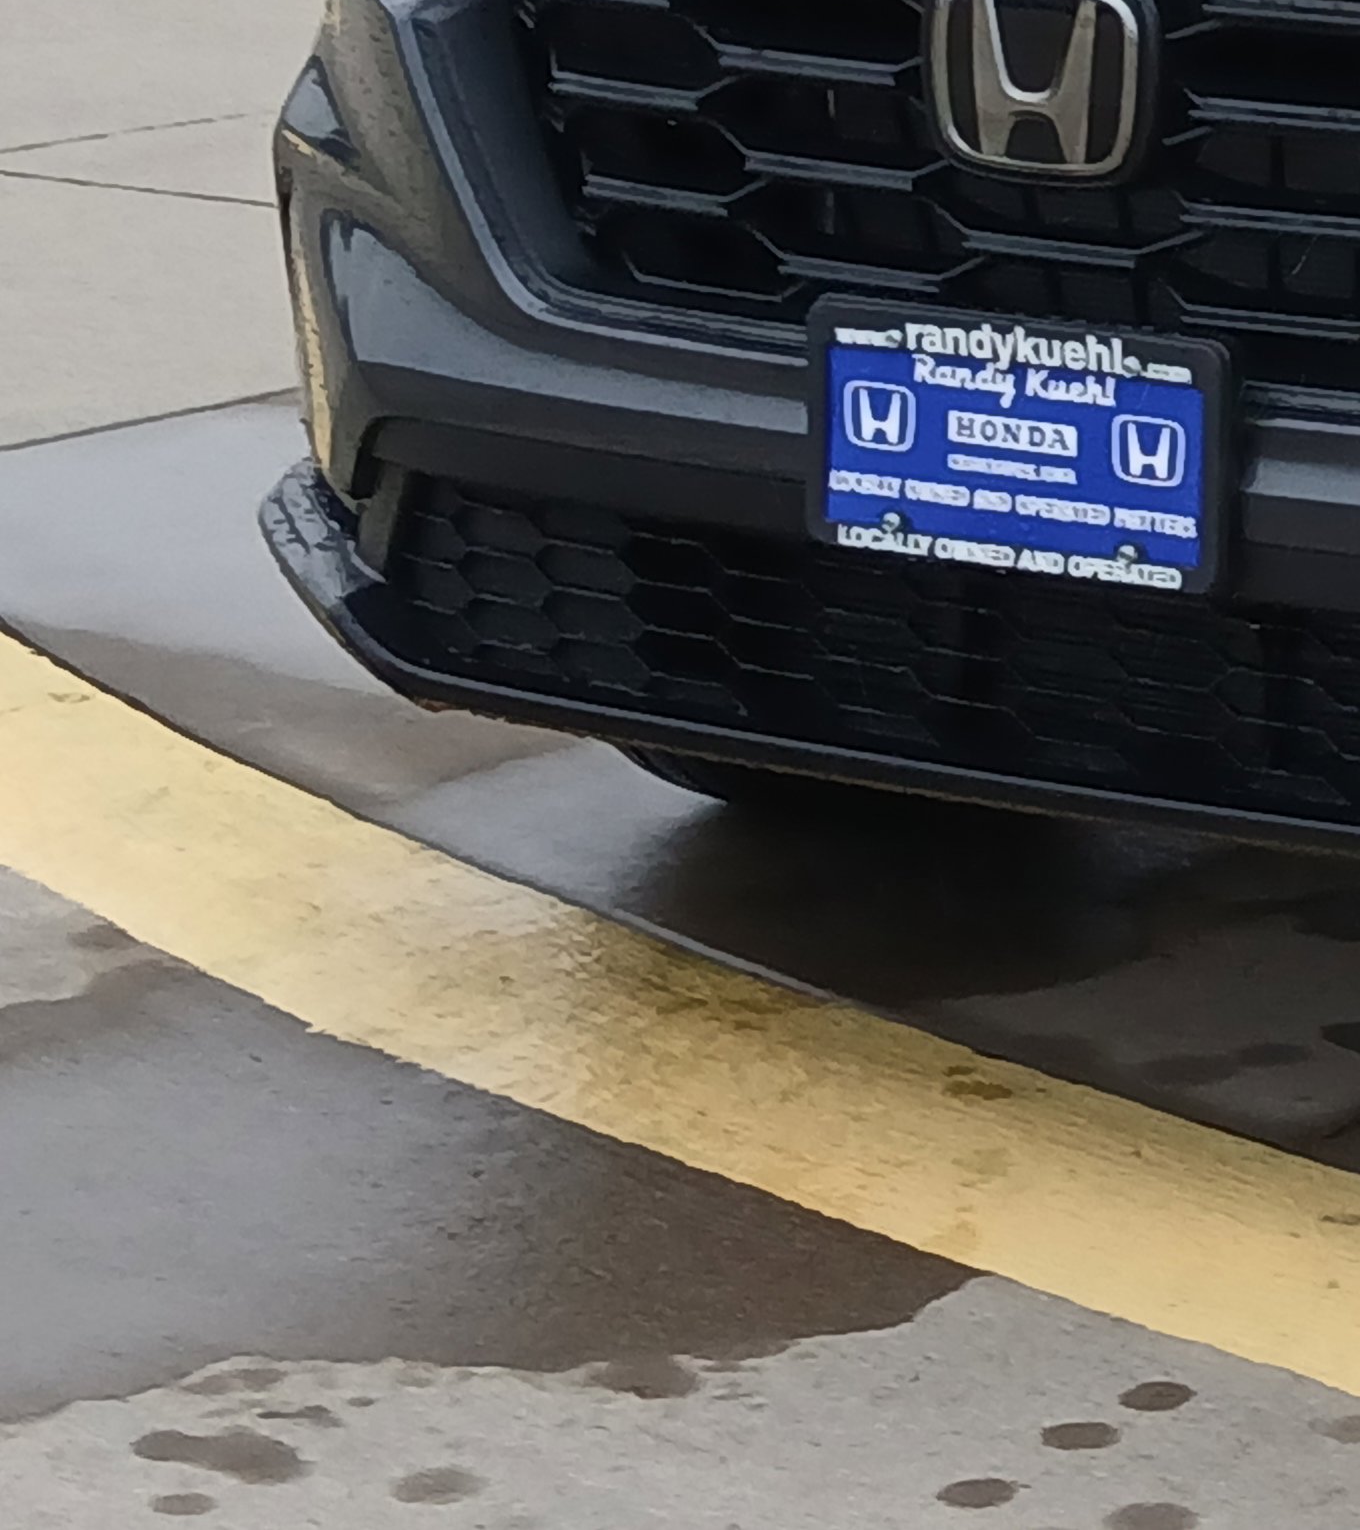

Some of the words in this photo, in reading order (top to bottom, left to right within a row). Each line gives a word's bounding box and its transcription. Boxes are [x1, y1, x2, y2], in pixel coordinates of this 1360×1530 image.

[911, 353, 1017, 409] Randy
[1025, 367, 1116, 407] Kuehl
[955, 416, 1070, 451] HONDA
